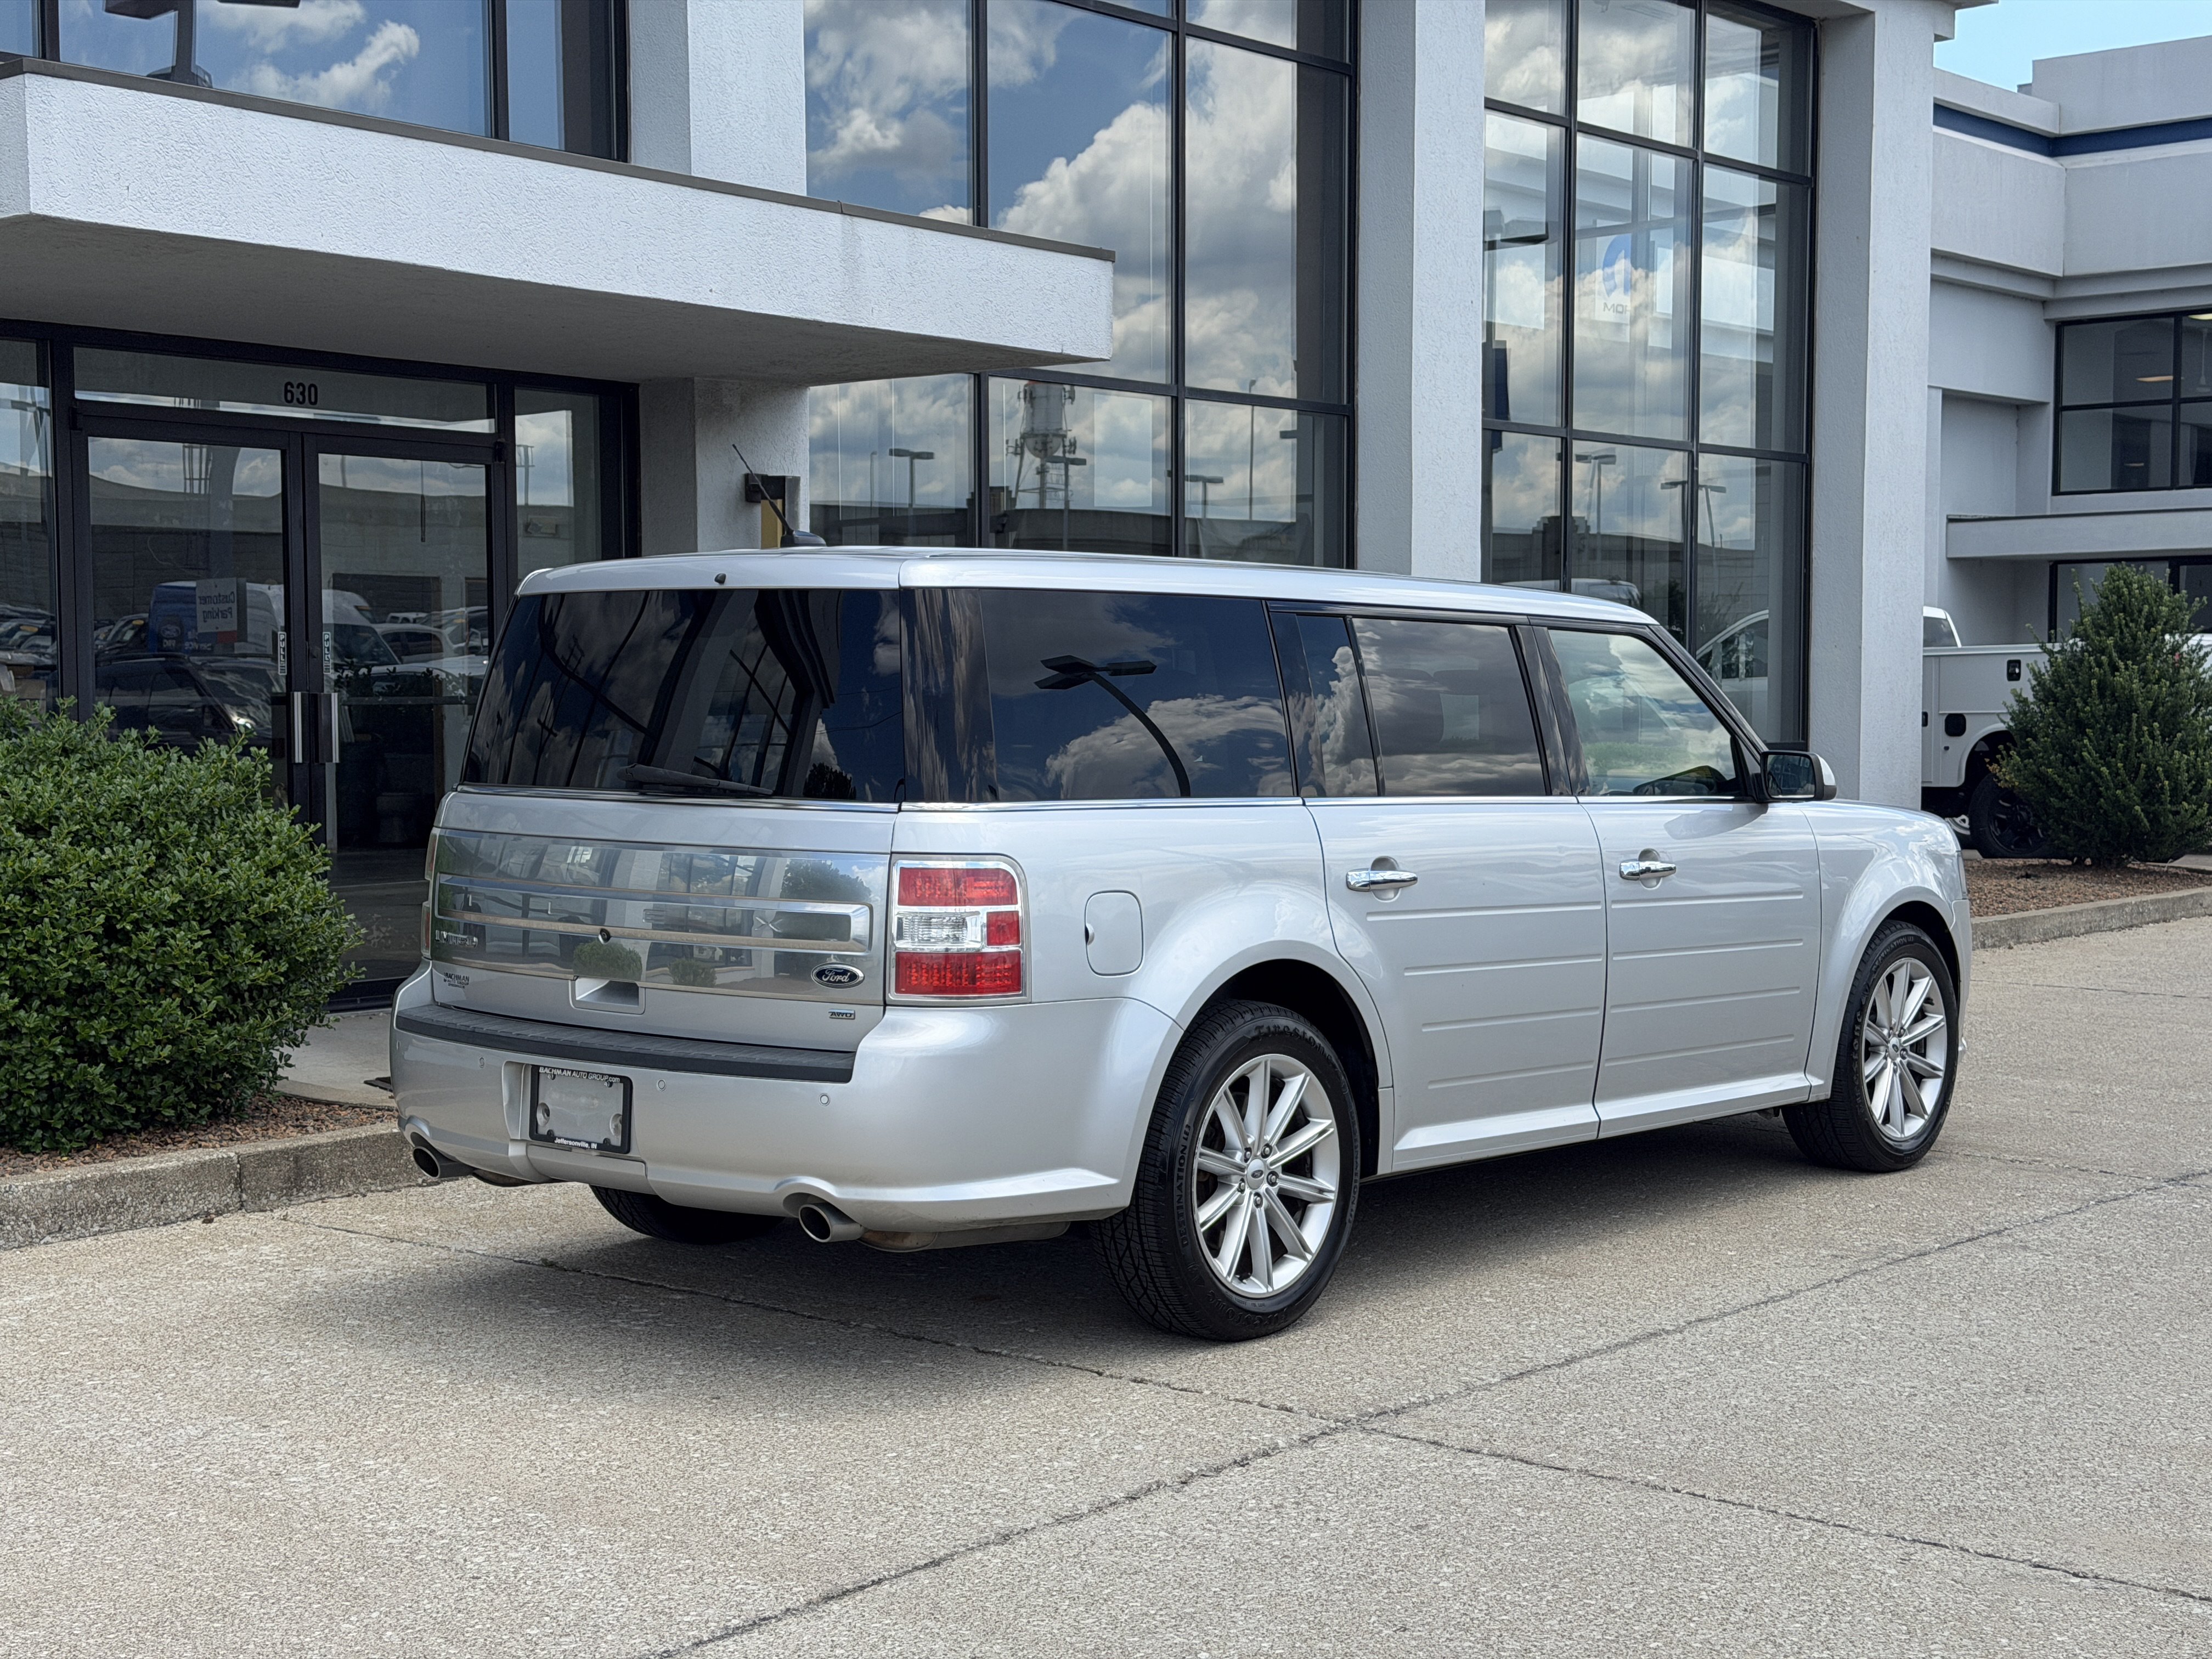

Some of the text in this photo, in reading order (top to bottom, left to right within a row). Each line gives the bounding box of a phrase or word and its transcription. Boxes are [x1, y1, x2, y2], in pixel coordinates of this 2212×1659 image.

[284, 381, 318, 405] 630
[822, 968, 850, 982] Ford
[829, 1011, 854, 1019] AWD
[539, 1066, 572, 1076] BACHMAN
[1176, 1123, 1192, 1249] DESTINATION LE3
